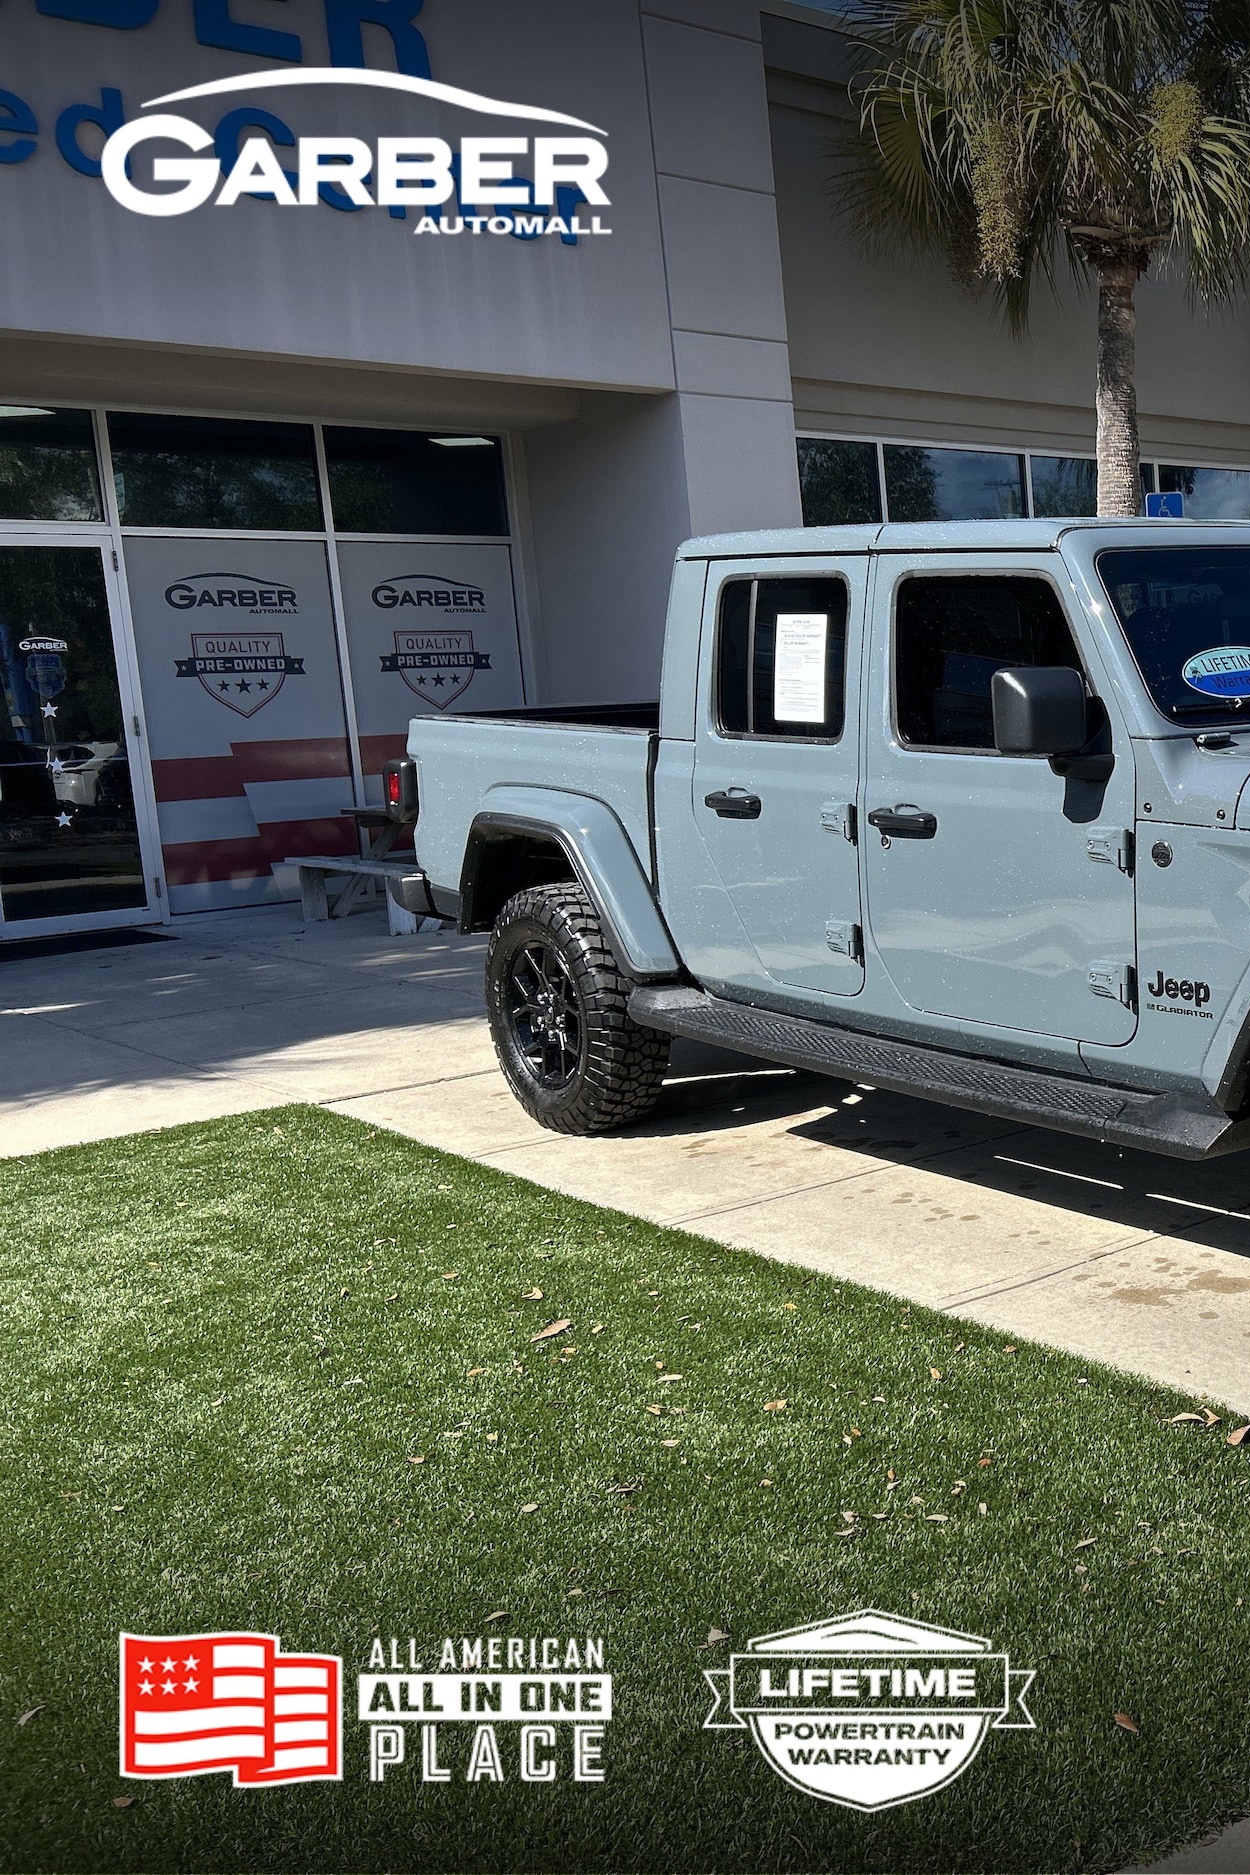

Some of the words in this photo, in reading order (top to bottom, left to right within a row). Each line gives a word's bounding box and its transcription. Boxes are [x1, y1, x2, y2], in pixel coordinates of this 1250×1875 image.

[165, 584, 298, 609] GARBER
[372, 585, 485, 608] GARBER
[19, 640, 68, 651] GARBER
[205, 640, 270, 653] QUALITY
[406, 638, 462, 650] QUALITY
[195, 658, 286, 671] PRE-OWNED
[397, 654, 475, 667] PRE-OWNED
[1147, 970, 1211, 1007] Jeep
[1156, 1004, 1214, 1019] GLADIATOR
